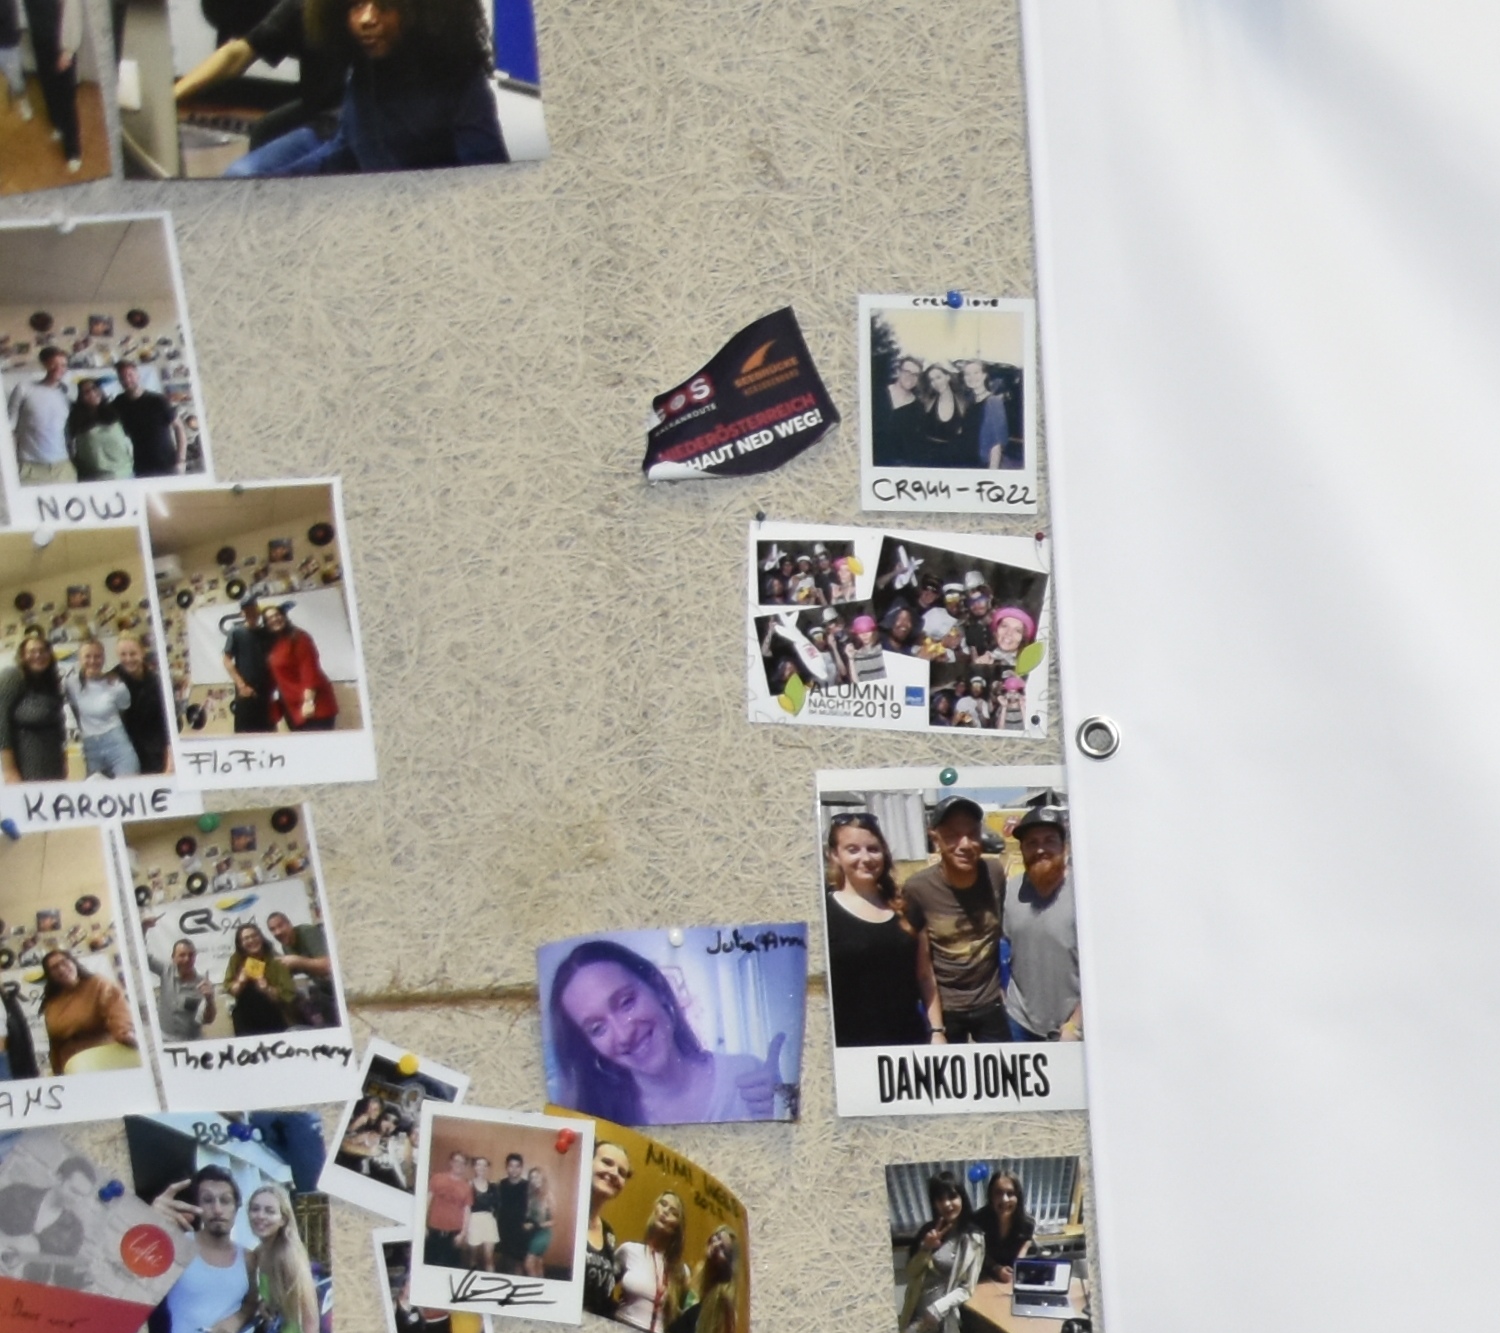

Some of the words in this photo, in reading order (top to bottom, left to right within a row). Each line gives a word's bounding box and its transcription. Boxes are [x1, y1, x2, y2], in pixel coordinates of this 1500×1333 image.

[738, 429, 775, 454] NED
[778, 409, 823, 440] WEG!
[809, 684, 895, 701] ALUMNI
[809, 698, 853, 711] NACHT
[852, 700, 902, 720] 2019
[877, 1049, 965, 1105] DANKO
[972, 1048, 1050, 1104] JONES
